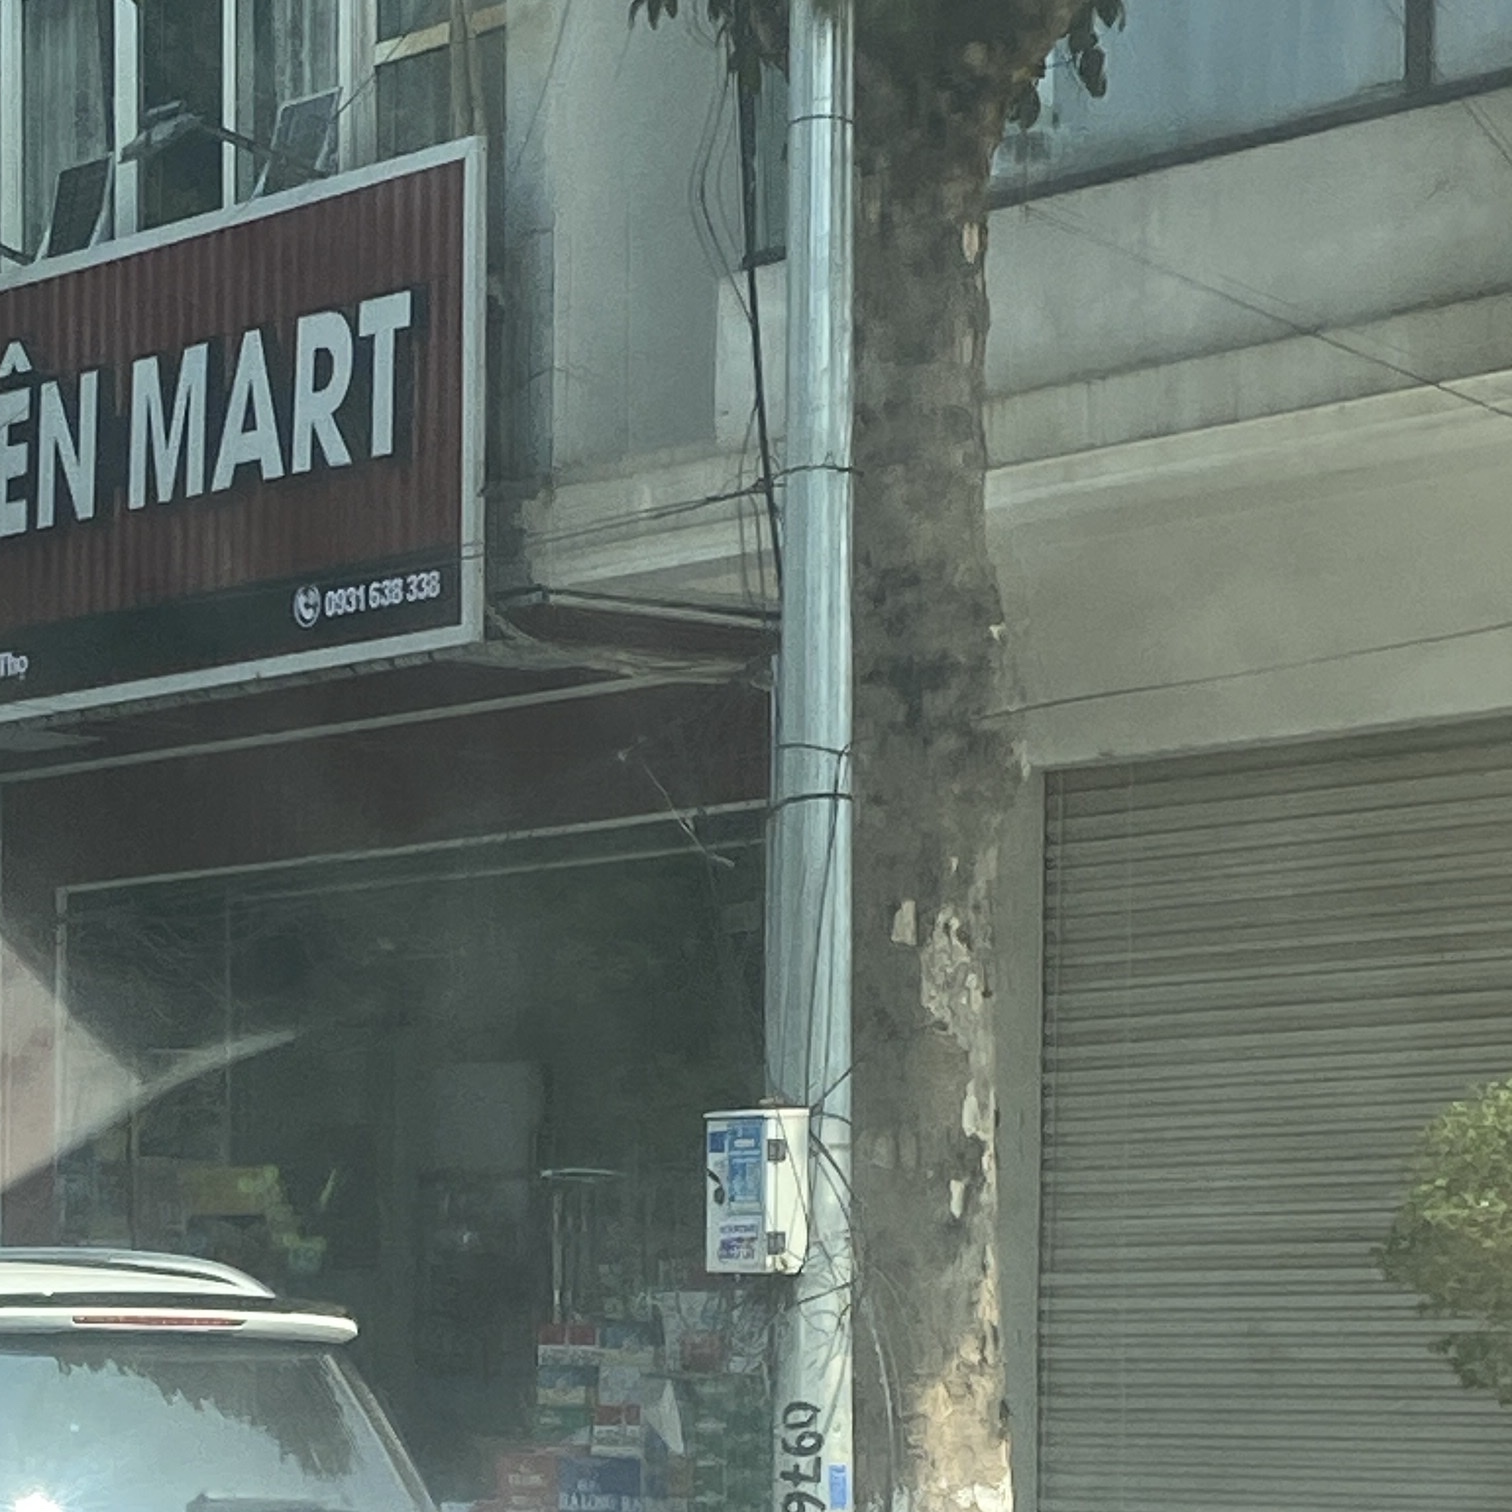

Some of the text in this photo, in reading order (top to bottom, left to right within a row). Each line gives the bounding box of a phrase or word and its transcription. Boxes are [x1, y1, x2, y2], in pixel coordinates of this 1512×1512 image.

[128, 290, 411, 511] MART
[324, 570, 440, 617] 0931 638 338
